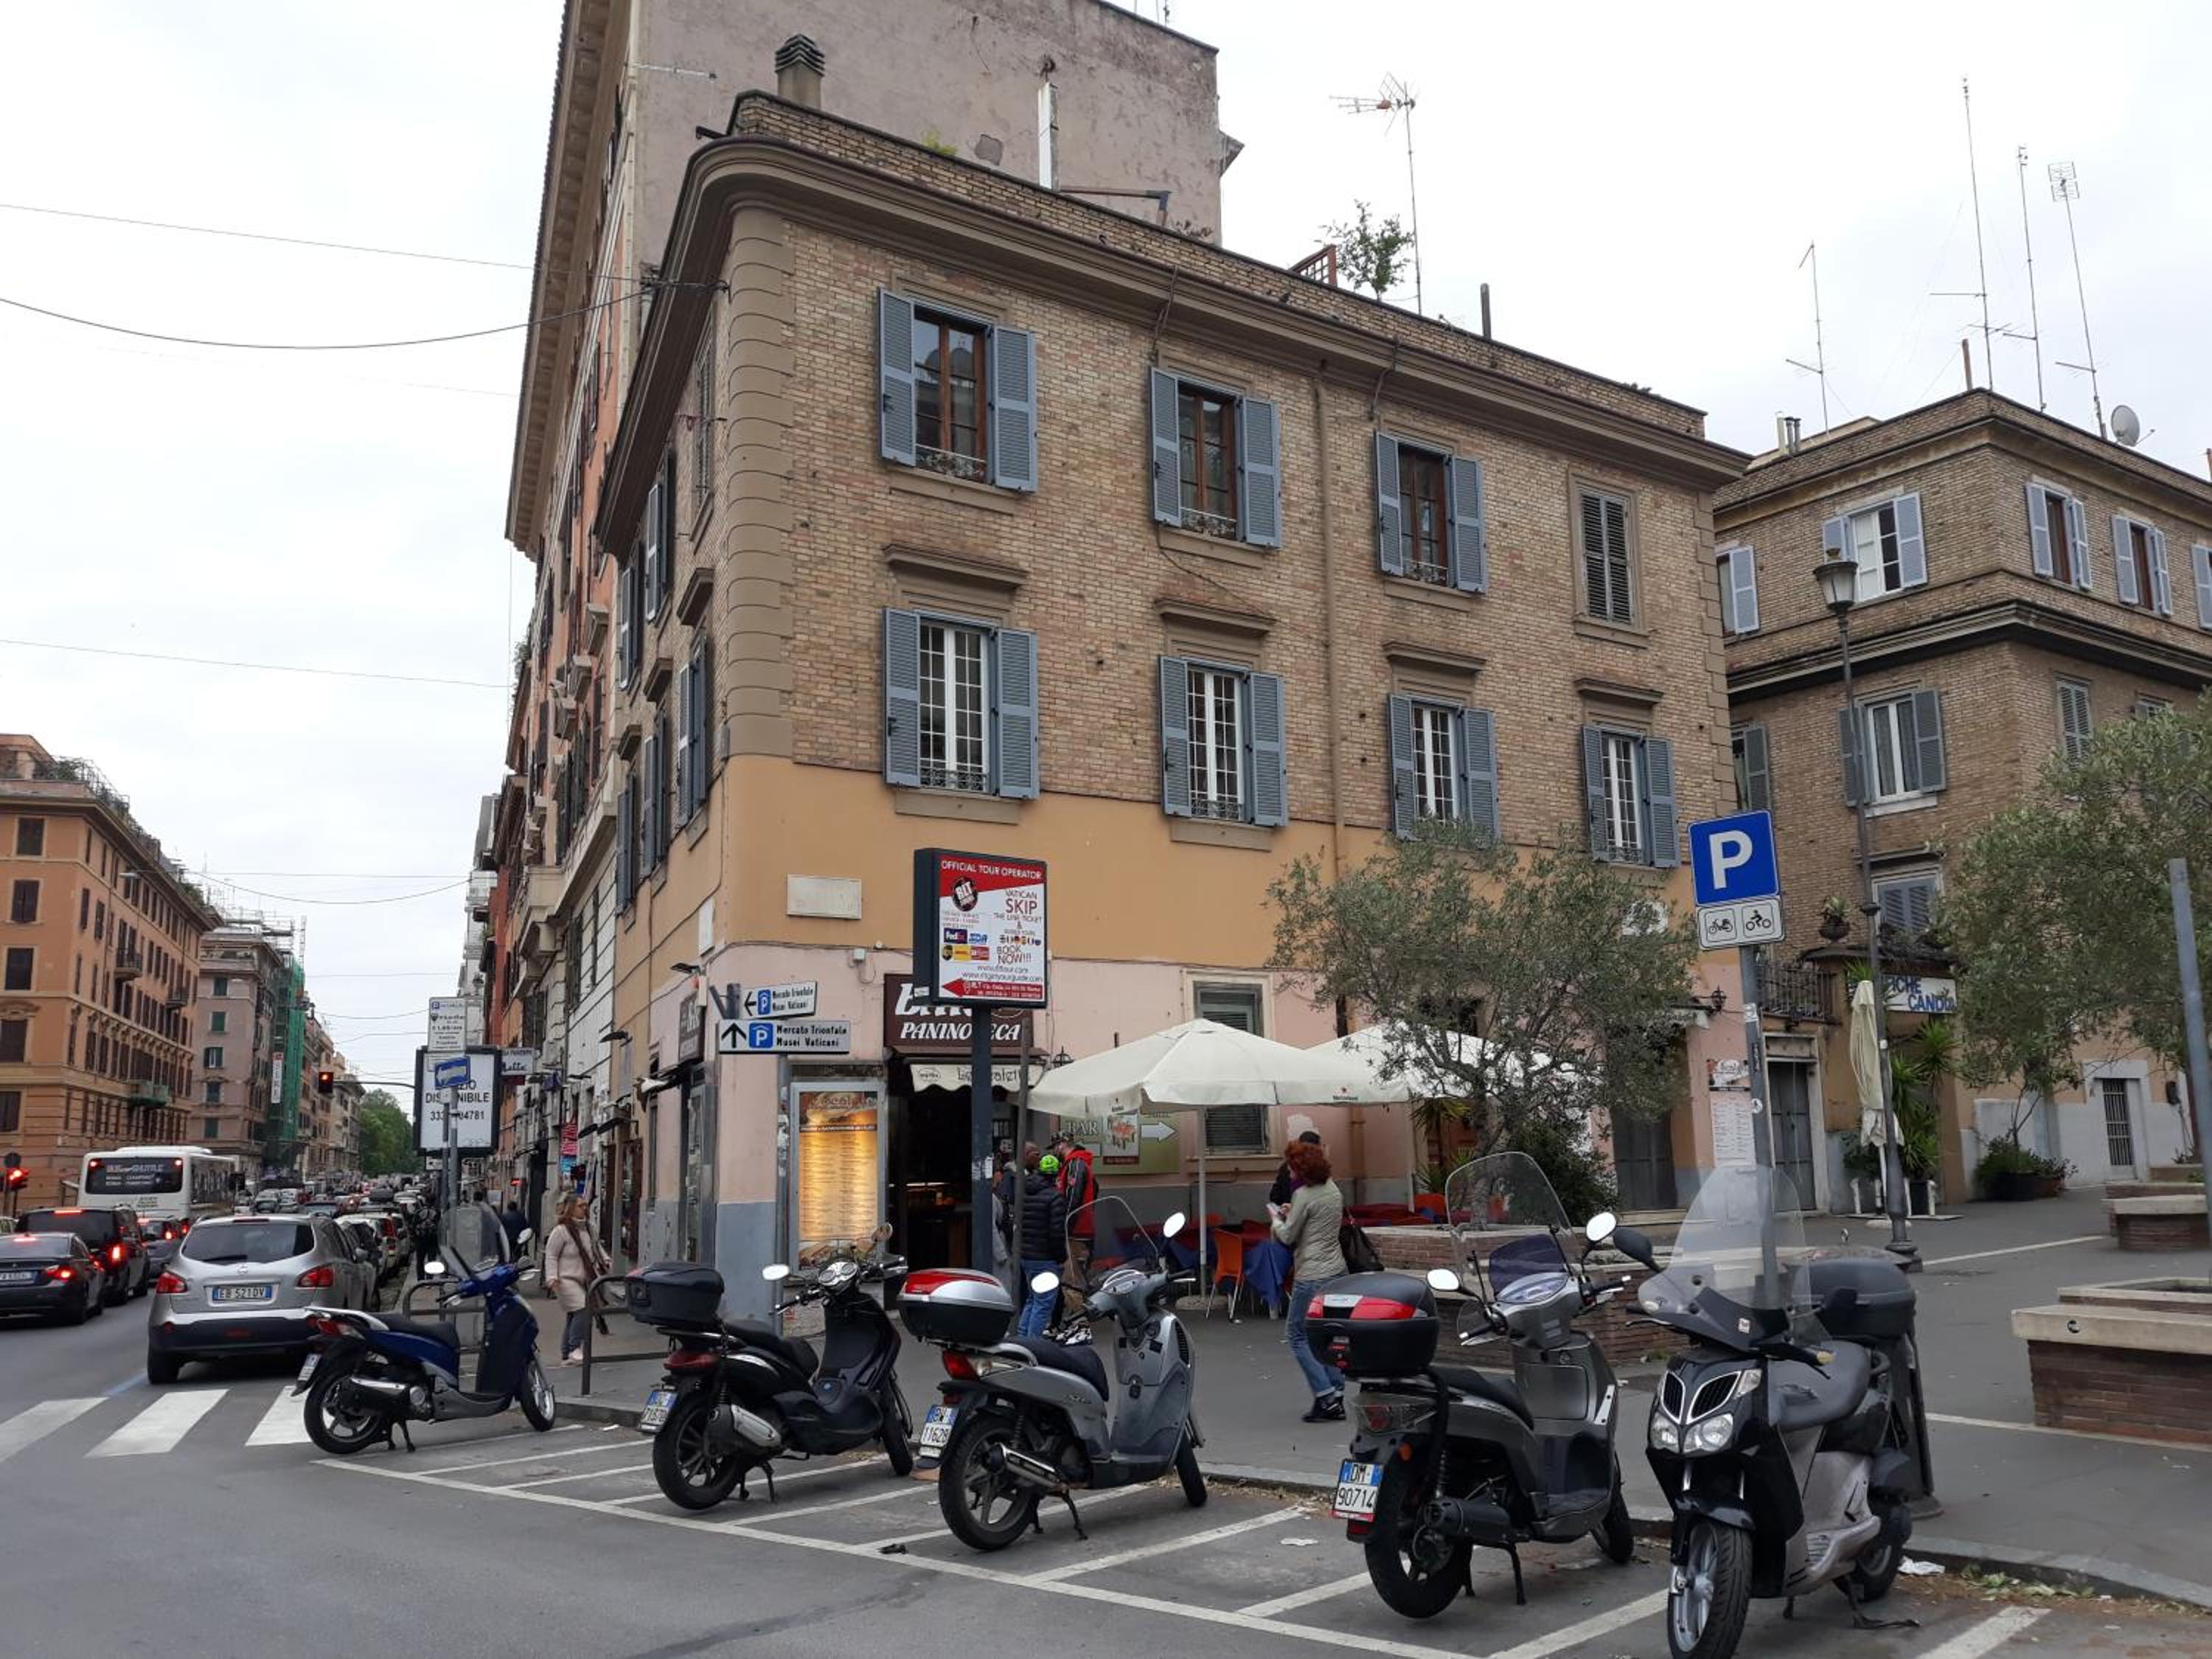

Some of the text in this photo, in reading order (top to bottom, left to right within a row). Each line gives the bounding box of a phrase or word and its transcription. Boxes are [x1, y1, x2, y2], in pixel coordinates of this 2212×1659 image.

[1708, 830, 1753, 890] P
[942, 860, 1042, 880] OFFICIAL TOUR OPERATOR
[1006, 890, 1037, 900] VATICAN
[1006, 898, 1037, 914] SKIP
[993, 912, 1005, 920] THE
[997, 945, 1021, 955] BOOK
[776, 1024, 847, 1034] Mercato Trionfale
[755, 1029, 768, 1046] P
[776, 1037, 839, 1046] Musei Vaticani
[425, 1093, 490, 1104] DISNIBILE
[1068, 1120, 1098, 1135] BAR
[1351, 1464, 1368, 1483] DM
